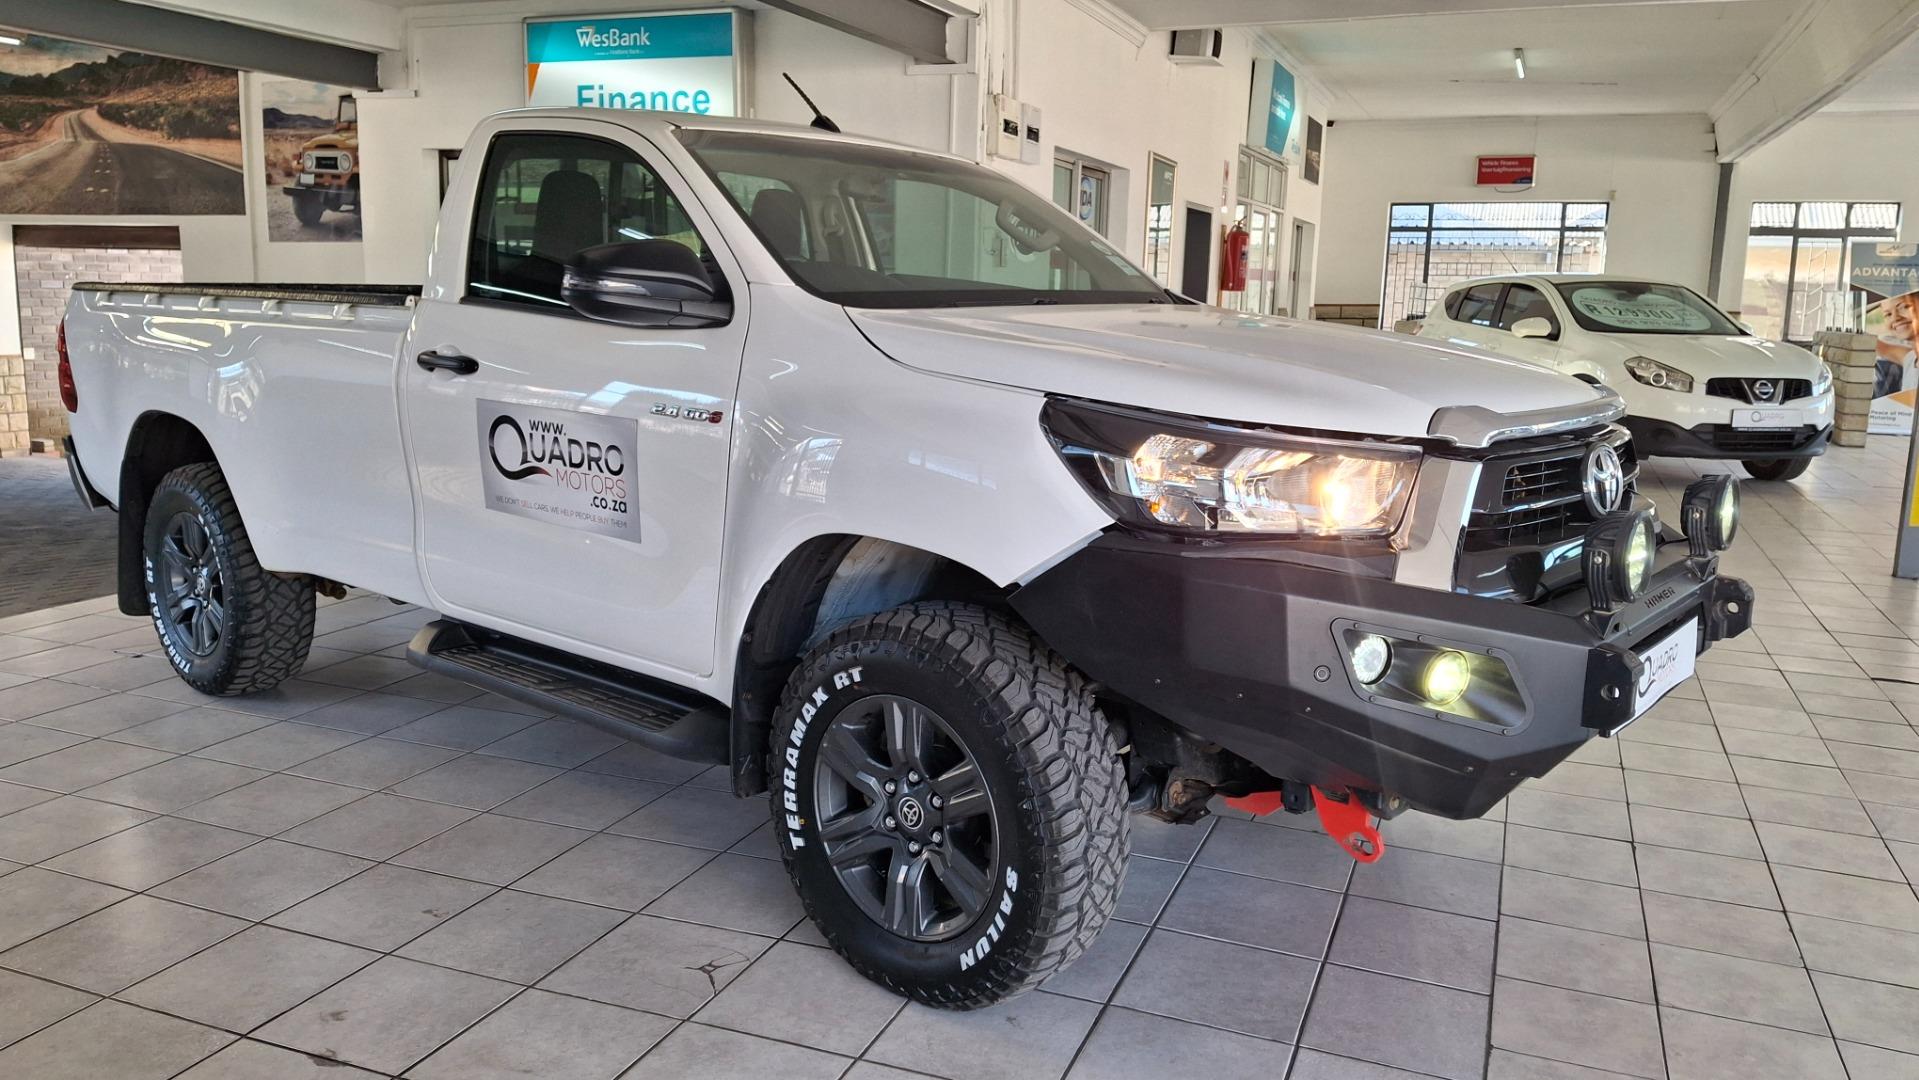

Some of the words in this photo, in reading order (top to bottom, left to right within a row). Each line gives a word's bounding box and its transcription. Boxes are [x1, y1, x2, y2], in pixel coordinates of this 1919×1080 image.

[575, 25, 651, 48] WesBank
[577, 84, 710, 115] Finance
[1851, 267, 1919, 278] ADVANTA
[529, 419, 567, 436] www.
[488, 414, 625, 481] QUADRO
[555, 467, 627, 500] MOTORS
[495, 495, 505, 504] WE
[549, 505, 561, 515] WE
[560, 508, 576, 518] HELP
[589, 495, 628, 514] .co.za
[148, 591, 192, 675] TERRAMAX
[783, 685, 830, 851] TERRAMAX
[832, 666, 864, 690] RT
[958, 865, 1019, 972] SAILUN
